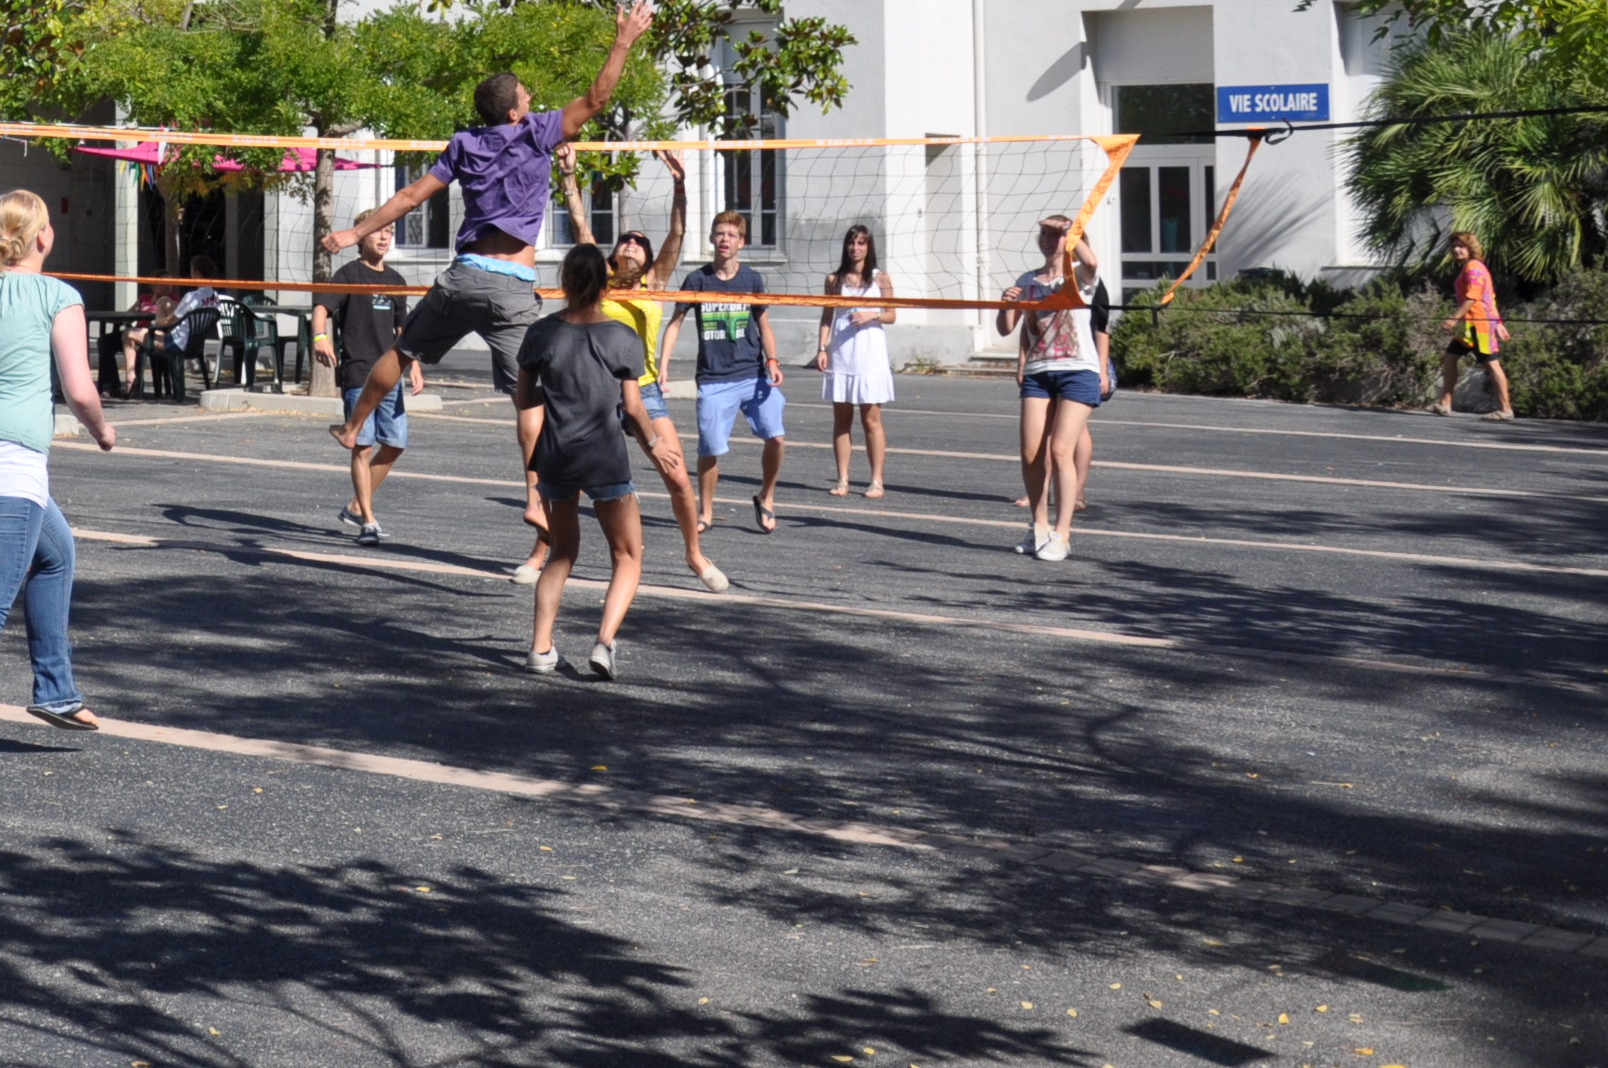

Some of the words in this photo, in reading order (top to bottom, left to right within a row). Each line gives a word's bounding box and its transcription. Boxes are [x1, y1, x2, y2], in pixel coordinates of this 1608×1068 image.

[1229, 94, 1251, 113] VIE
[1254, 92, 1318, 112] SCOLAIRE
[701, 330, 726, 341] OTOR
